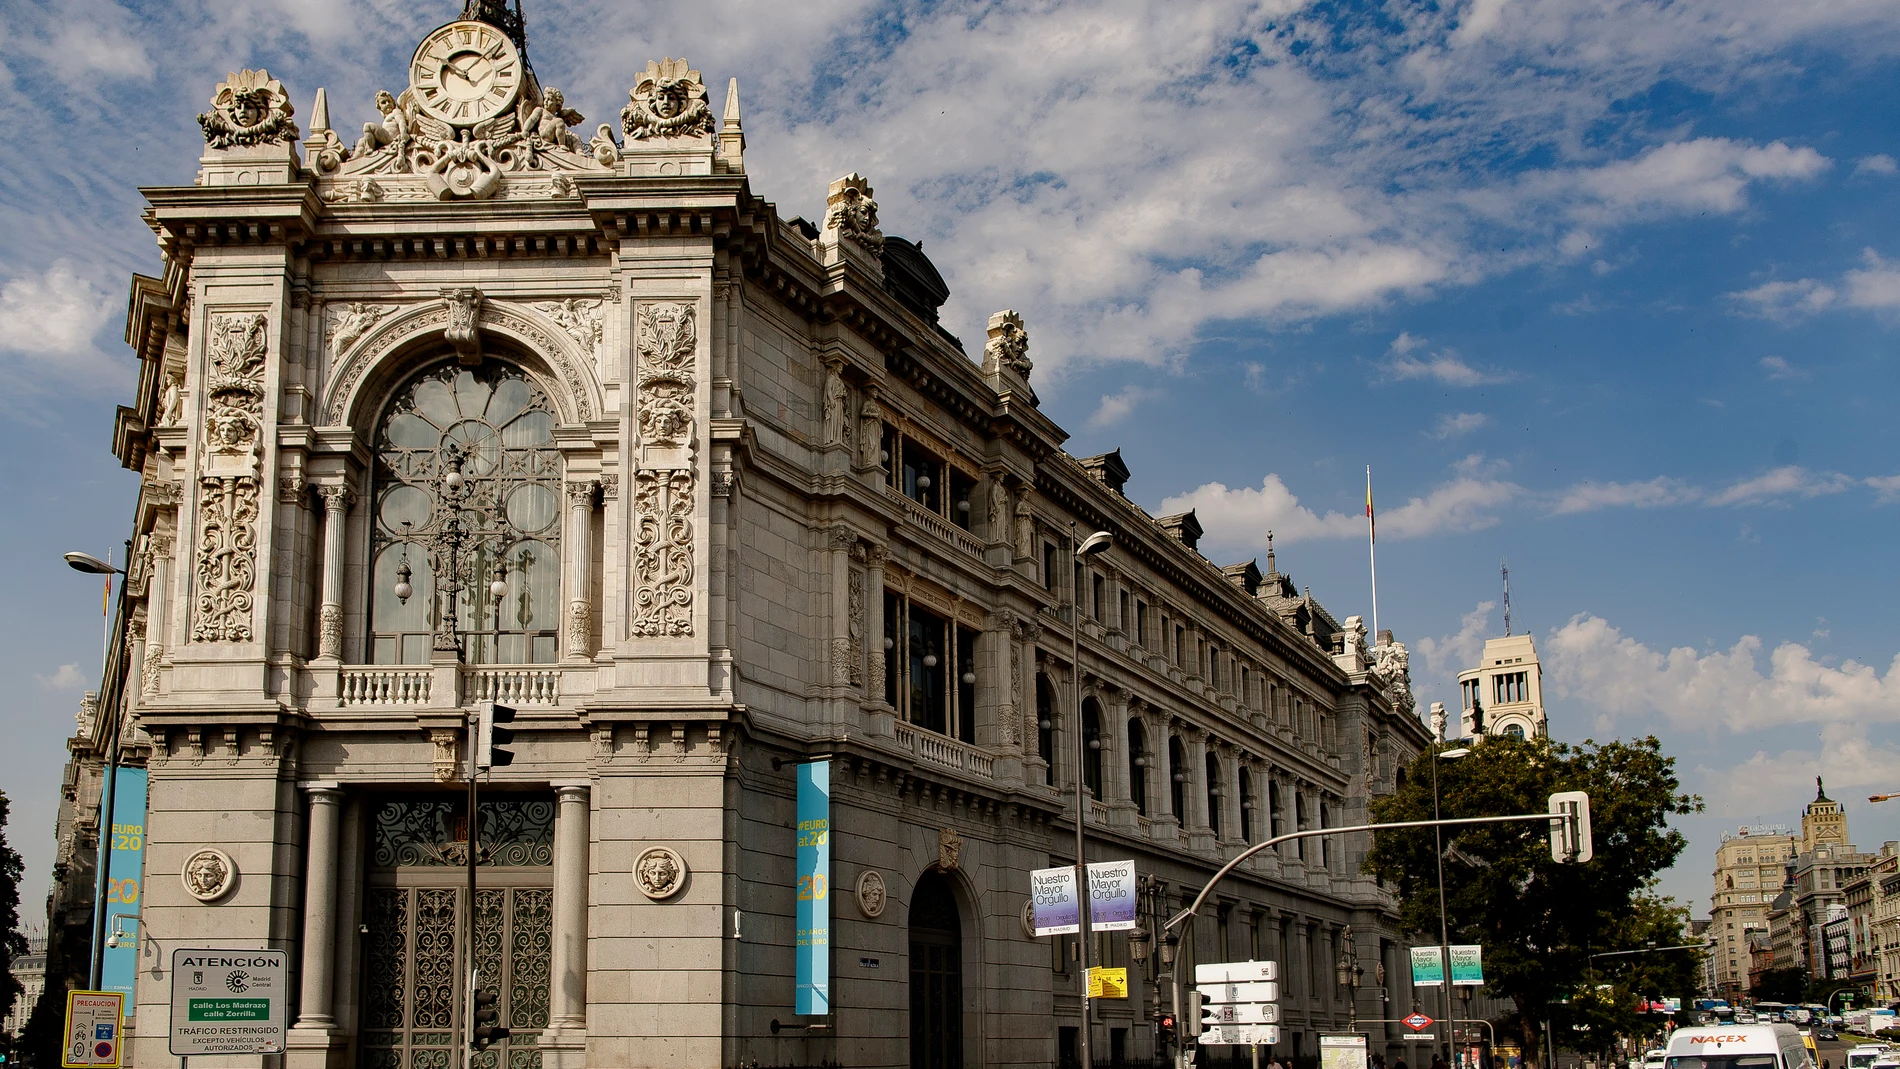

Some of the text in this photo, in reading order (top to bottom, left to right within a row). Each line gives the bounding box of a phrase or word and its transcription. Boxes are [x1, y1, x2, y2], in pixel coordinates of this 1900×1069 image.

[798, 819, 828, 831] #EURO
[1750, 823, 1786, 832] GENERALI
[118, 836, 142, 851] 20
[798, 830, 827, 847] at 20
[1090, 868, 1128, 879] Nuestro
[1034, 874, 1070, 886] Nuestro
[1091, 879, 1121, 890] Mayor
[798, 874, 827, 900] 20
[1035, 885, 1064, 897] Mayor
[1036, 893, 1069, 907] Orgullo
[1093, 889, 1127, 901] Orgullo
[182, 957, 279, 968] ATENCIÓN
[178, 1026, 279, 1035] TRÁFICO RESTRINGIDO
[1690, 1035, 1748, 1044] NACEX
